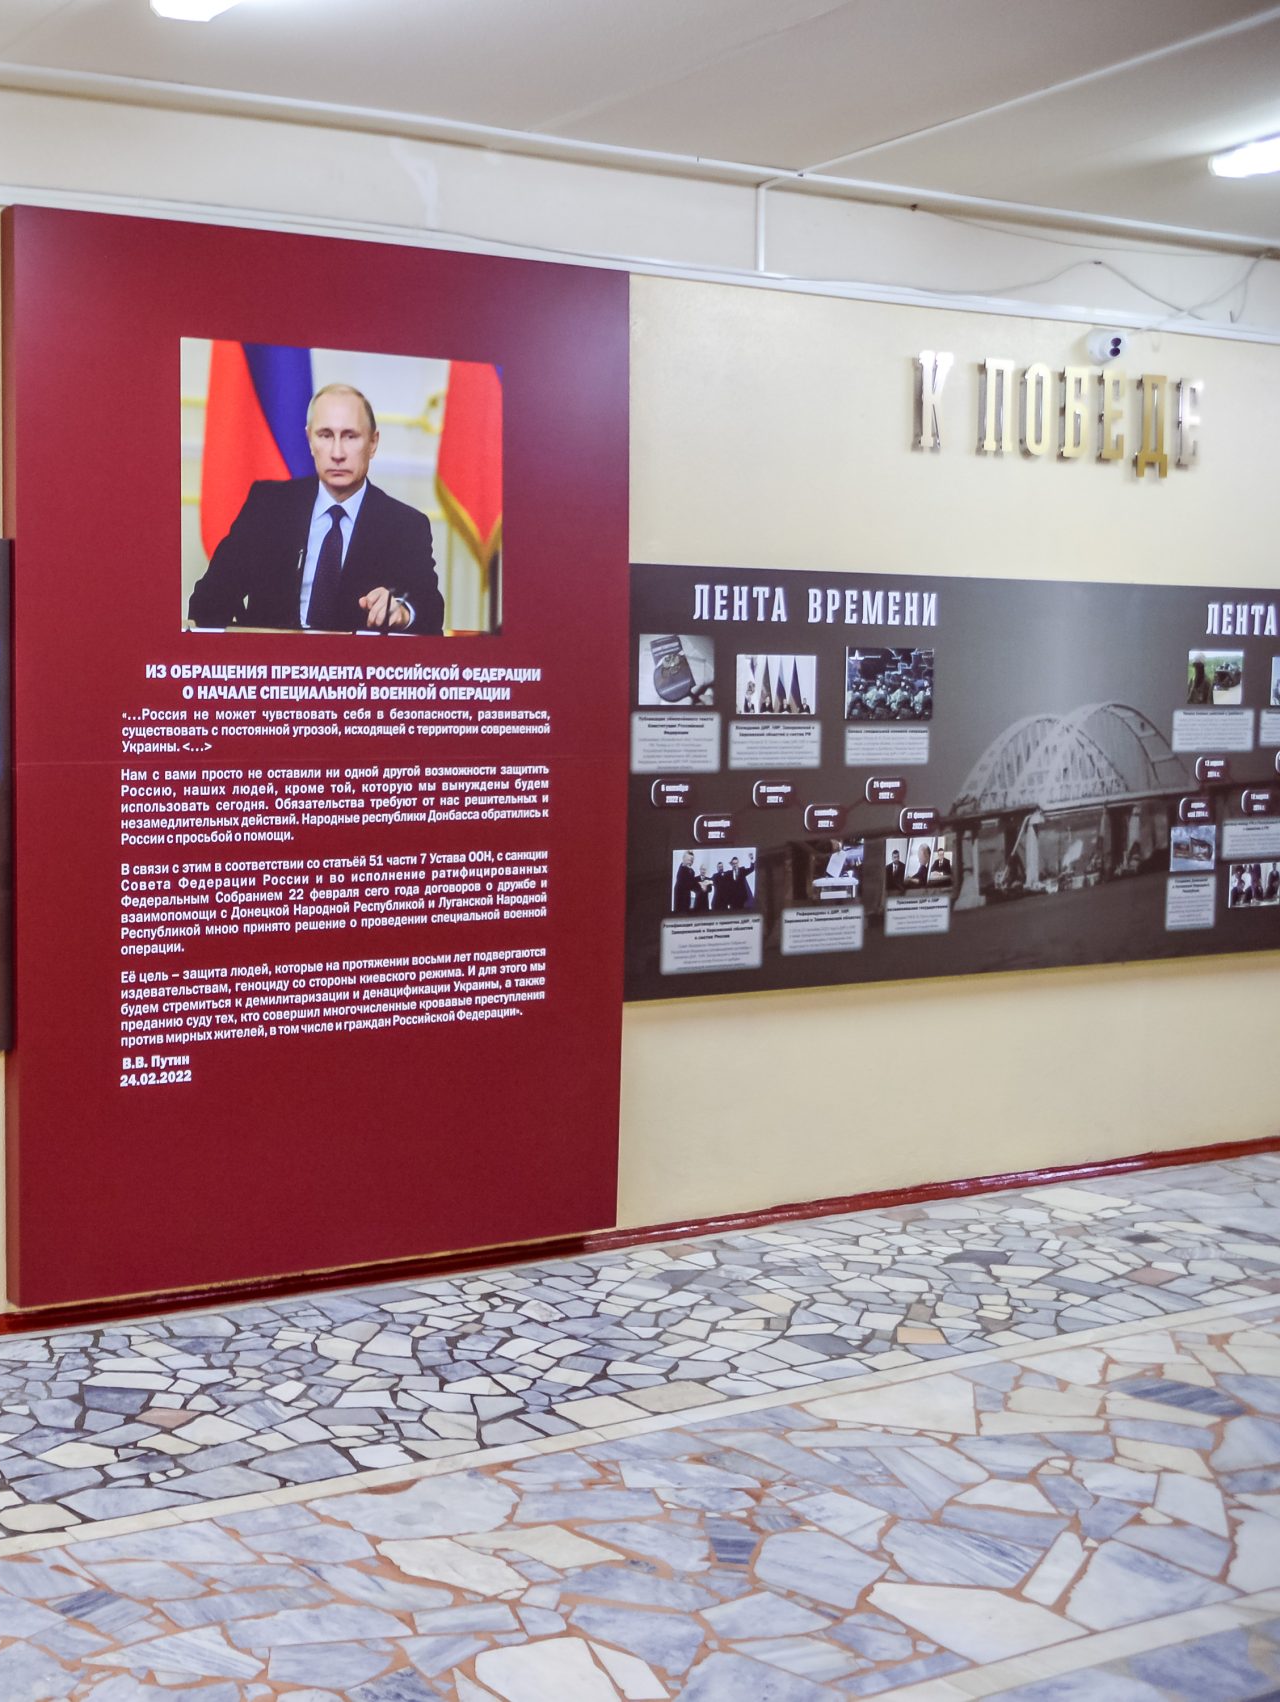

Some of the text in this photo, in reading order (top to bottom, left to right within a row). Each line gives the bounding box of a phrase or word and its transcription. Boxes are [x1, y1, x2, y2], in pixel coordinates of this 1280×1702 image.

[917, 350, 1204, 478] К ПОБЕДЕ
[693, 584, 937, 627] ЛЕНТА ВРЕМЕНИ
[1205, 603, 1277, 635] ЛЕНТА
[145, 664, 541, 683] ИЗ ОБРАЩЕНИЯ ПРЕЗИДЕНТА РОССИЙСКОЙ ФЕДЕРАЦИИ
[182, 684, 511, 703] О НАЧАЛЕ СПЕЦИАЛЬНОЙ ВОЕННОЙ ОПЕРАЦИИ
[193, 710, 209, 720] не
[215, 710, 256, 720] может
[262, 710, 338, 722] чувствовать
[343, 708, 371, 720] себя
[376, 710, 384, 719] в
[389, 708, 473, 721] безопасности,
[477, 710, 551, 721] развиваться,
[121, 723, 551, 739] существовать с постоянной угрозой, исходящей с территории современной
[122, 740, 180, 755] Украины.
[121, 765, 550, 782] Нам с вами просто не оставили ни одной другой возможности защитить
[121, 778, 549, 798] Россию, наших людей, кроме той, которую мы вынуждены будем
[120, 794, 549, 813] использовать сегодня. Обязательства требуют от нас решительных и
[121, 808, 549, 830] незамедлительных действий. Народные республики Донбасса обратились к
[121, 830, 294, 846] России с просьбой о помощи.
[121, 850, 548, 876] В связи с этим в соответствии со статьёй 51 части 7 Устава ООН, с санкции
[120, 865, 548, 891] Совета Федерации России и во исполнение ратифицированных
[120, 878, 548, 909] Федеральным Собранием 22 февраля сего года договоров о дружбе и
[120, 891, 547, 924] взаимопомощи с Донецкой Народной Республикой и Луганской Народной
[120, 906, 547, 940] Республикой мною принято решение о проведении специальной военной
[120, 943, 185, 956] операции.
[122, 1054, 190, 1070] В.В. Путин
[120, 1069, 192, 1087] 24.02.2022
